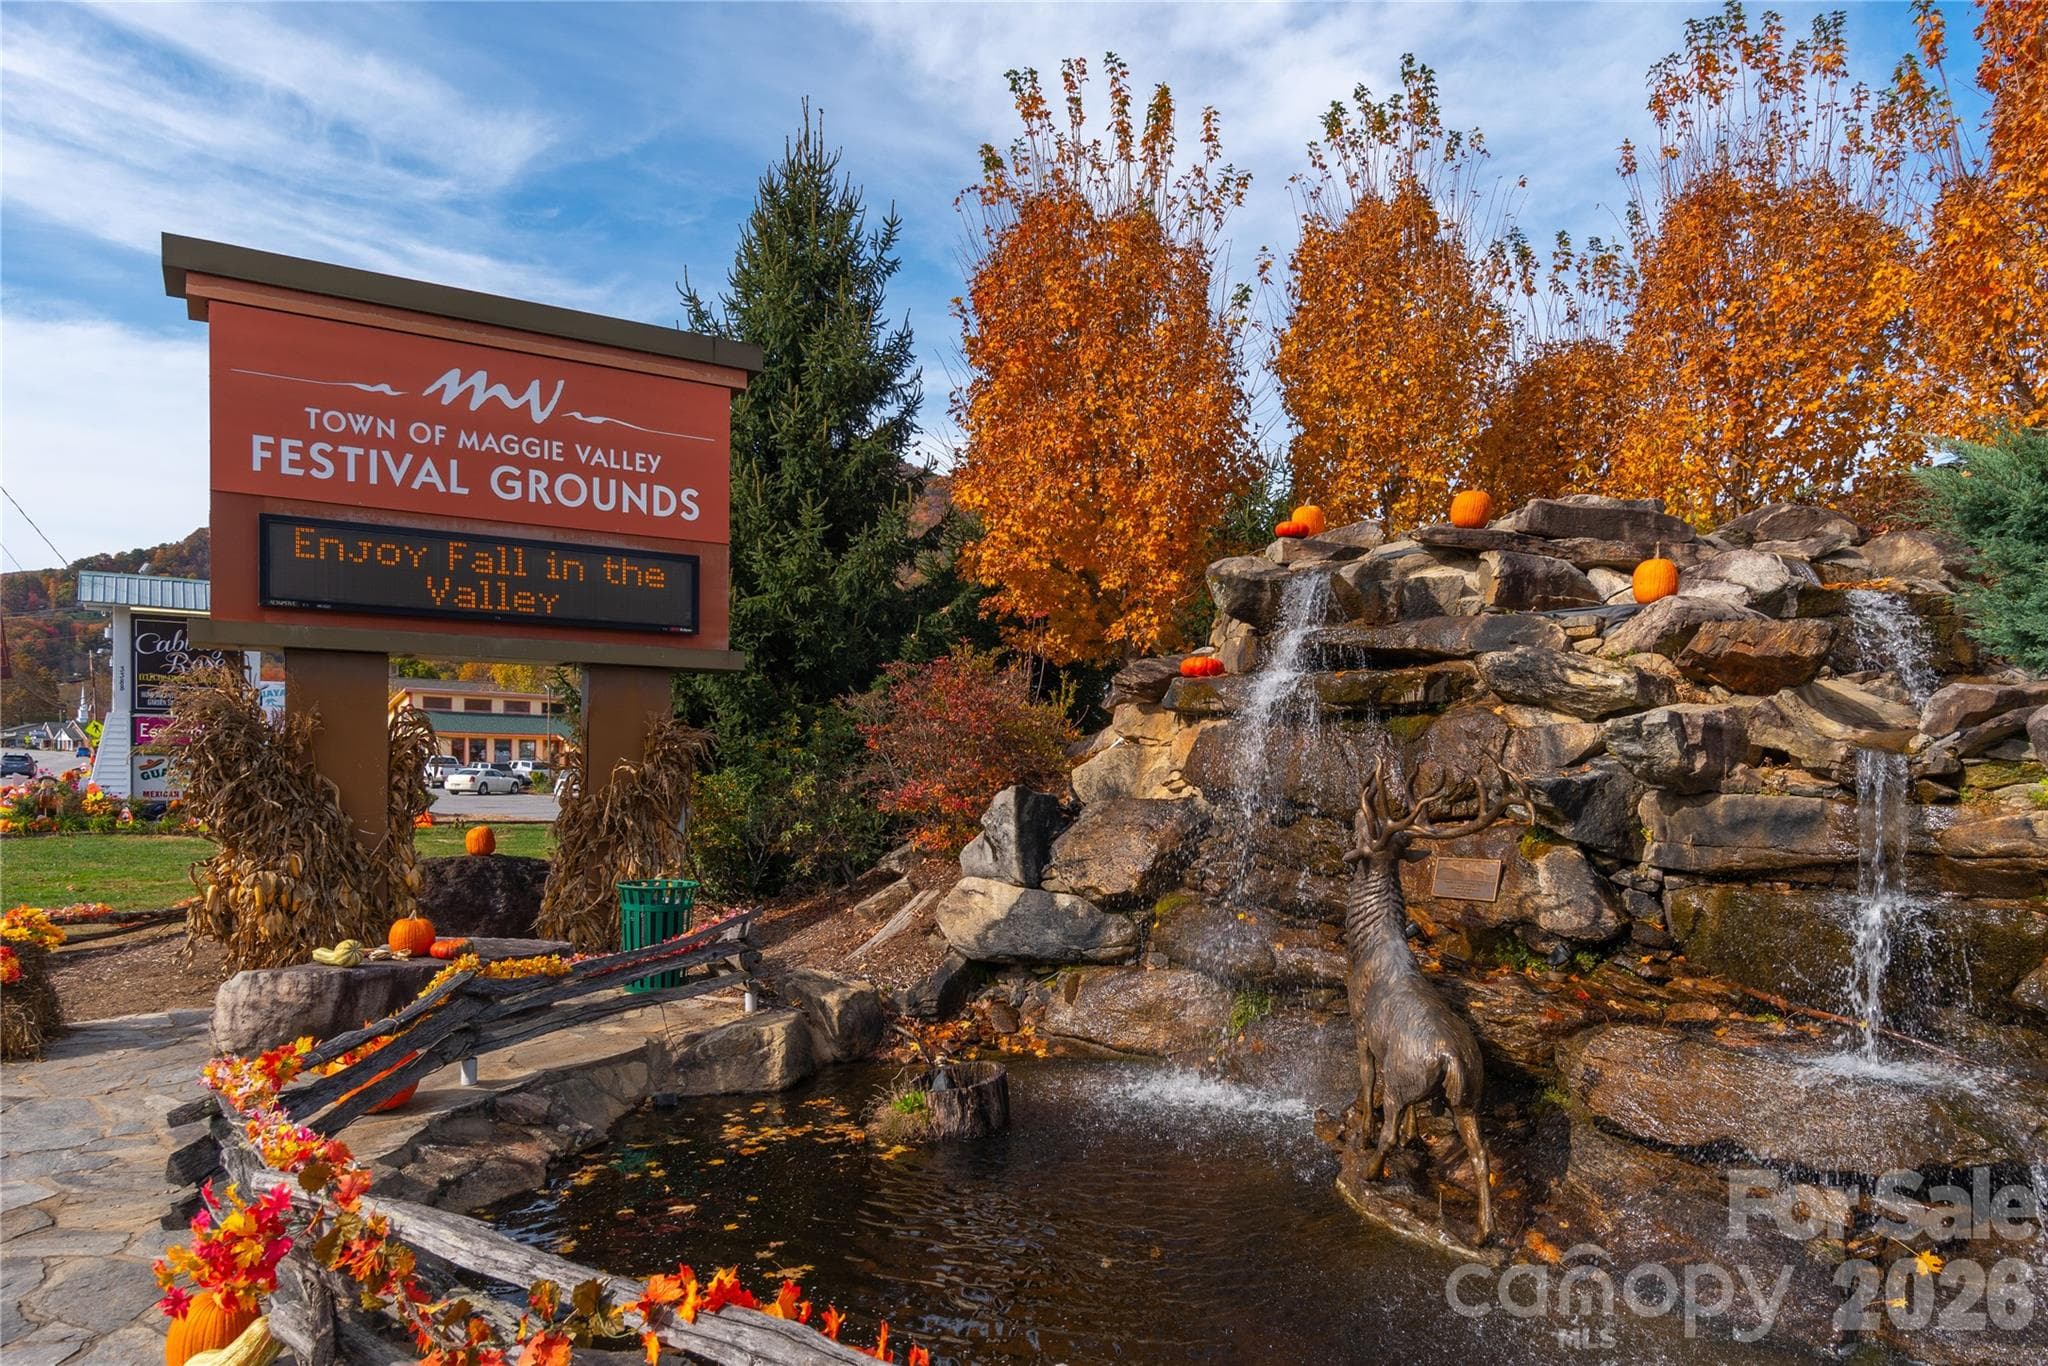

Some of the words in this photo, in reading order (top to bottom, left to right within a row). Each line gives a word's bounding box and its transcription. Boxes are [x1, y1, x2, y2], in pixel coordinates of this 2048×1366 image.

[304, 407, 395, 440] TOWN
[409, 422, 447, 446] OF
[458, 429, 564, 462] MAGGIE
[575, 443, 662, 474] VALLEY
[252, 434, 470, 495] FESTIVAL
[490, 464, 701, 521] GROUNDS
[448, 542, 527, 577] Fall
[546, 551, 584, 581] in
[602, 555, 665, 589] the
[426, 575, 560, 615] Valley
[142, 790, 180, 798] MEXICAN
